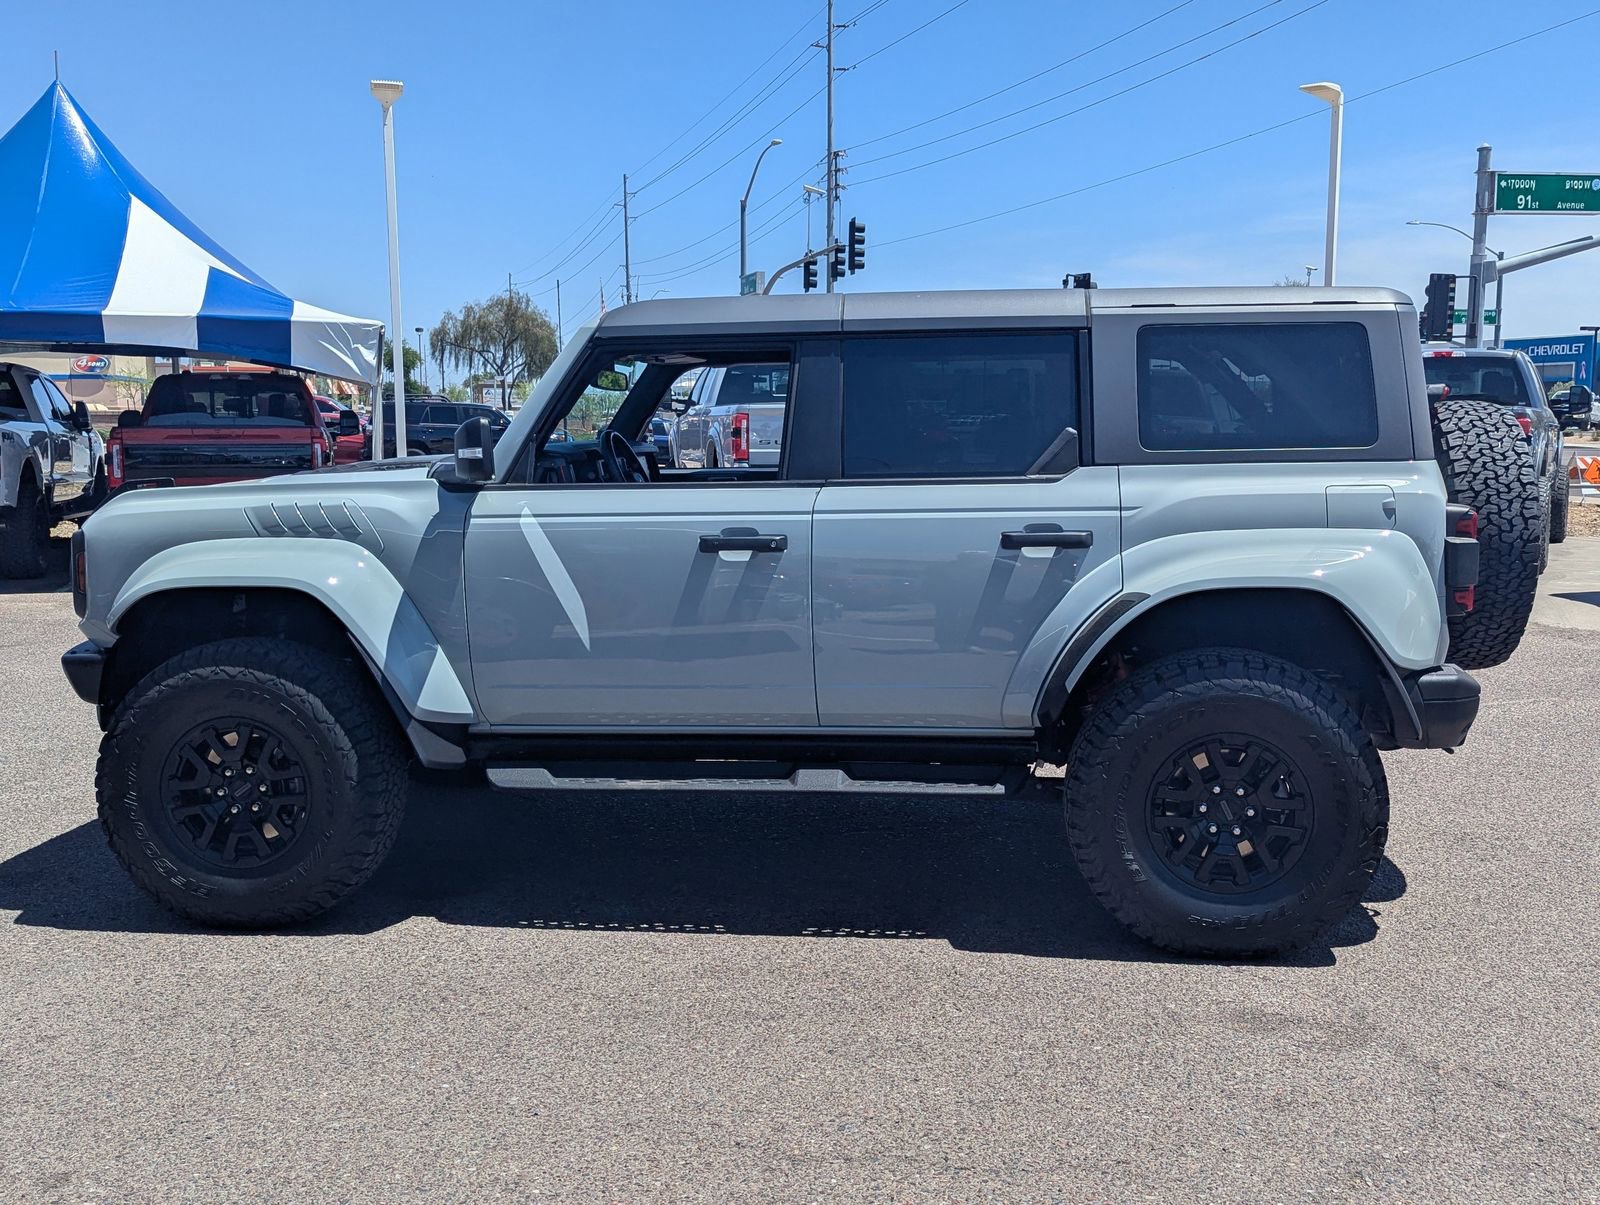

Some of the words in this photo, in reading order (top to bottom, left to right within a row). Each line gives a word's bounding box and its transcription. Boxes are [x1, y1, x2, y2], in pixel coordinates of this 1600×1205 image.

[1556, 201, 1585, 209] Avenue
[1528, 343, 1585, 357] CHEVROLET
[77, 358, 88, 367] 4
